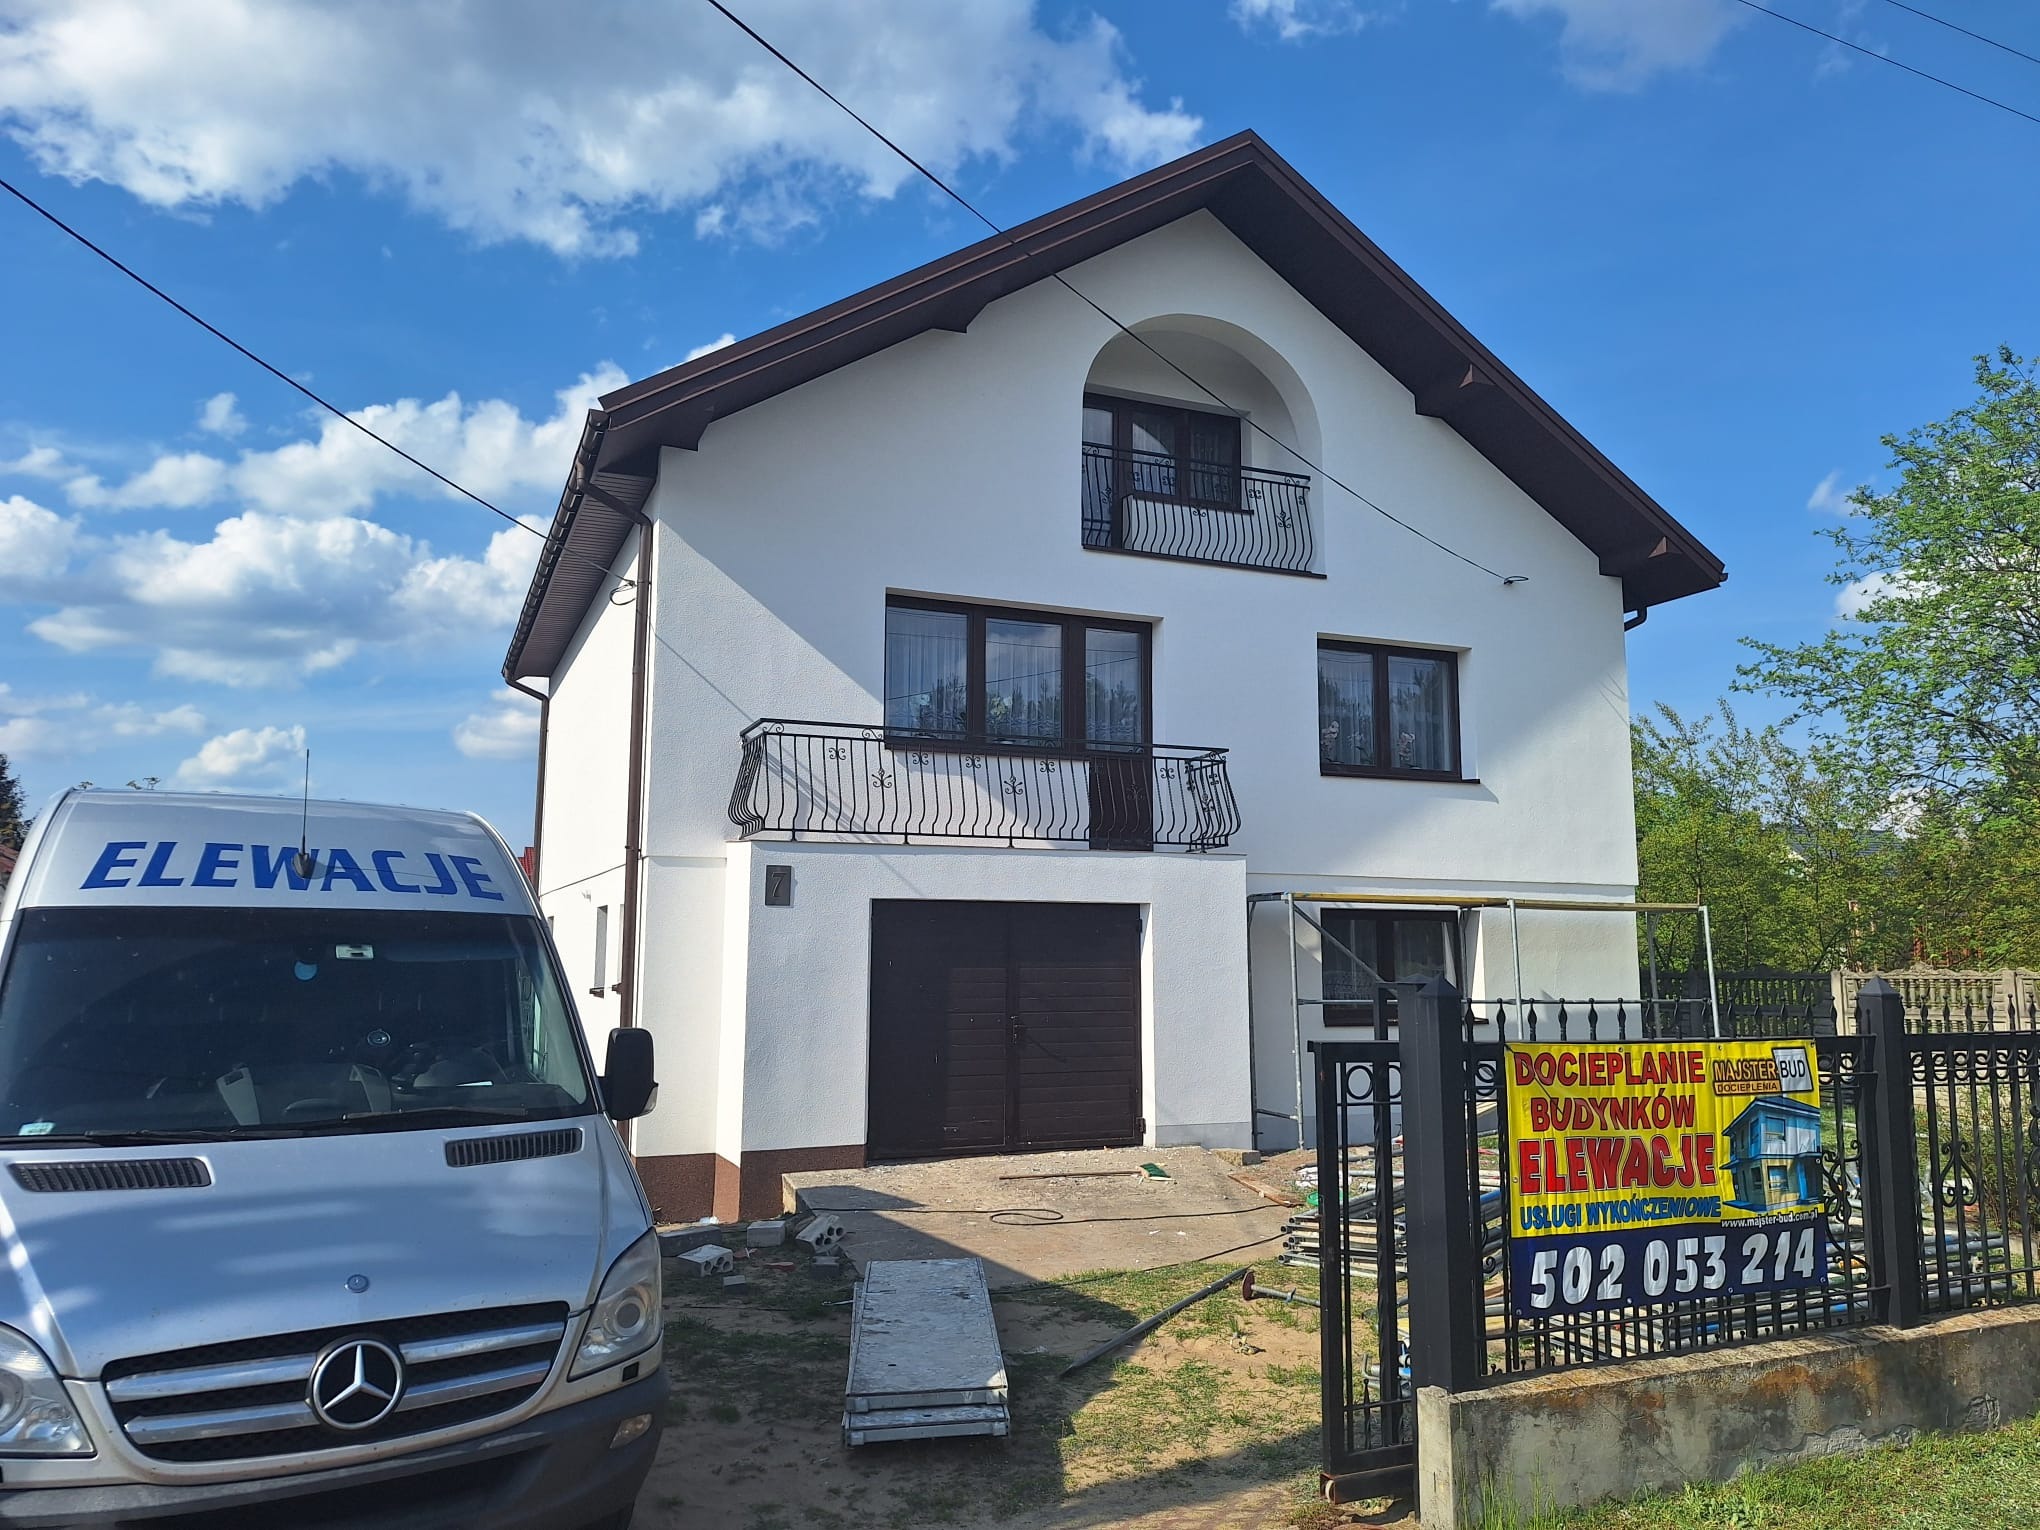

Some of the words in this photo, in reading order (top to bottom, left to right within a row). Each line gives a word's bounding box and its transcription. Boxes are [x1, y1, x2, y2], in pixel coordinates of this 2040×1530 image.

[79, 841, 504, 901] ELEWACJE
[771, 871, 788, 897] 7
[1515, 1051, 1705, 1086] DOCIEPLANIE
[1717, 1082, 1778, 1092] DOCIEPLENIA
[1530, 1088, 1695, 1132] BUDYNKÓW
[1517, 1133, 1718, 1196] ELEWACJE
[1520, 1205, 1582, 1231] USŁUGI
[1585, 1193, 1722, 1227] WYKOŃCZENIOWE
[1721, 1208, 1818, 1228] www.majster-bud.com.pl
[1530, 1243, 1626, 1309] 502
[1643, 1235, 1727, 1297] 053
[1741, 1227, 1815, 1286] 214
